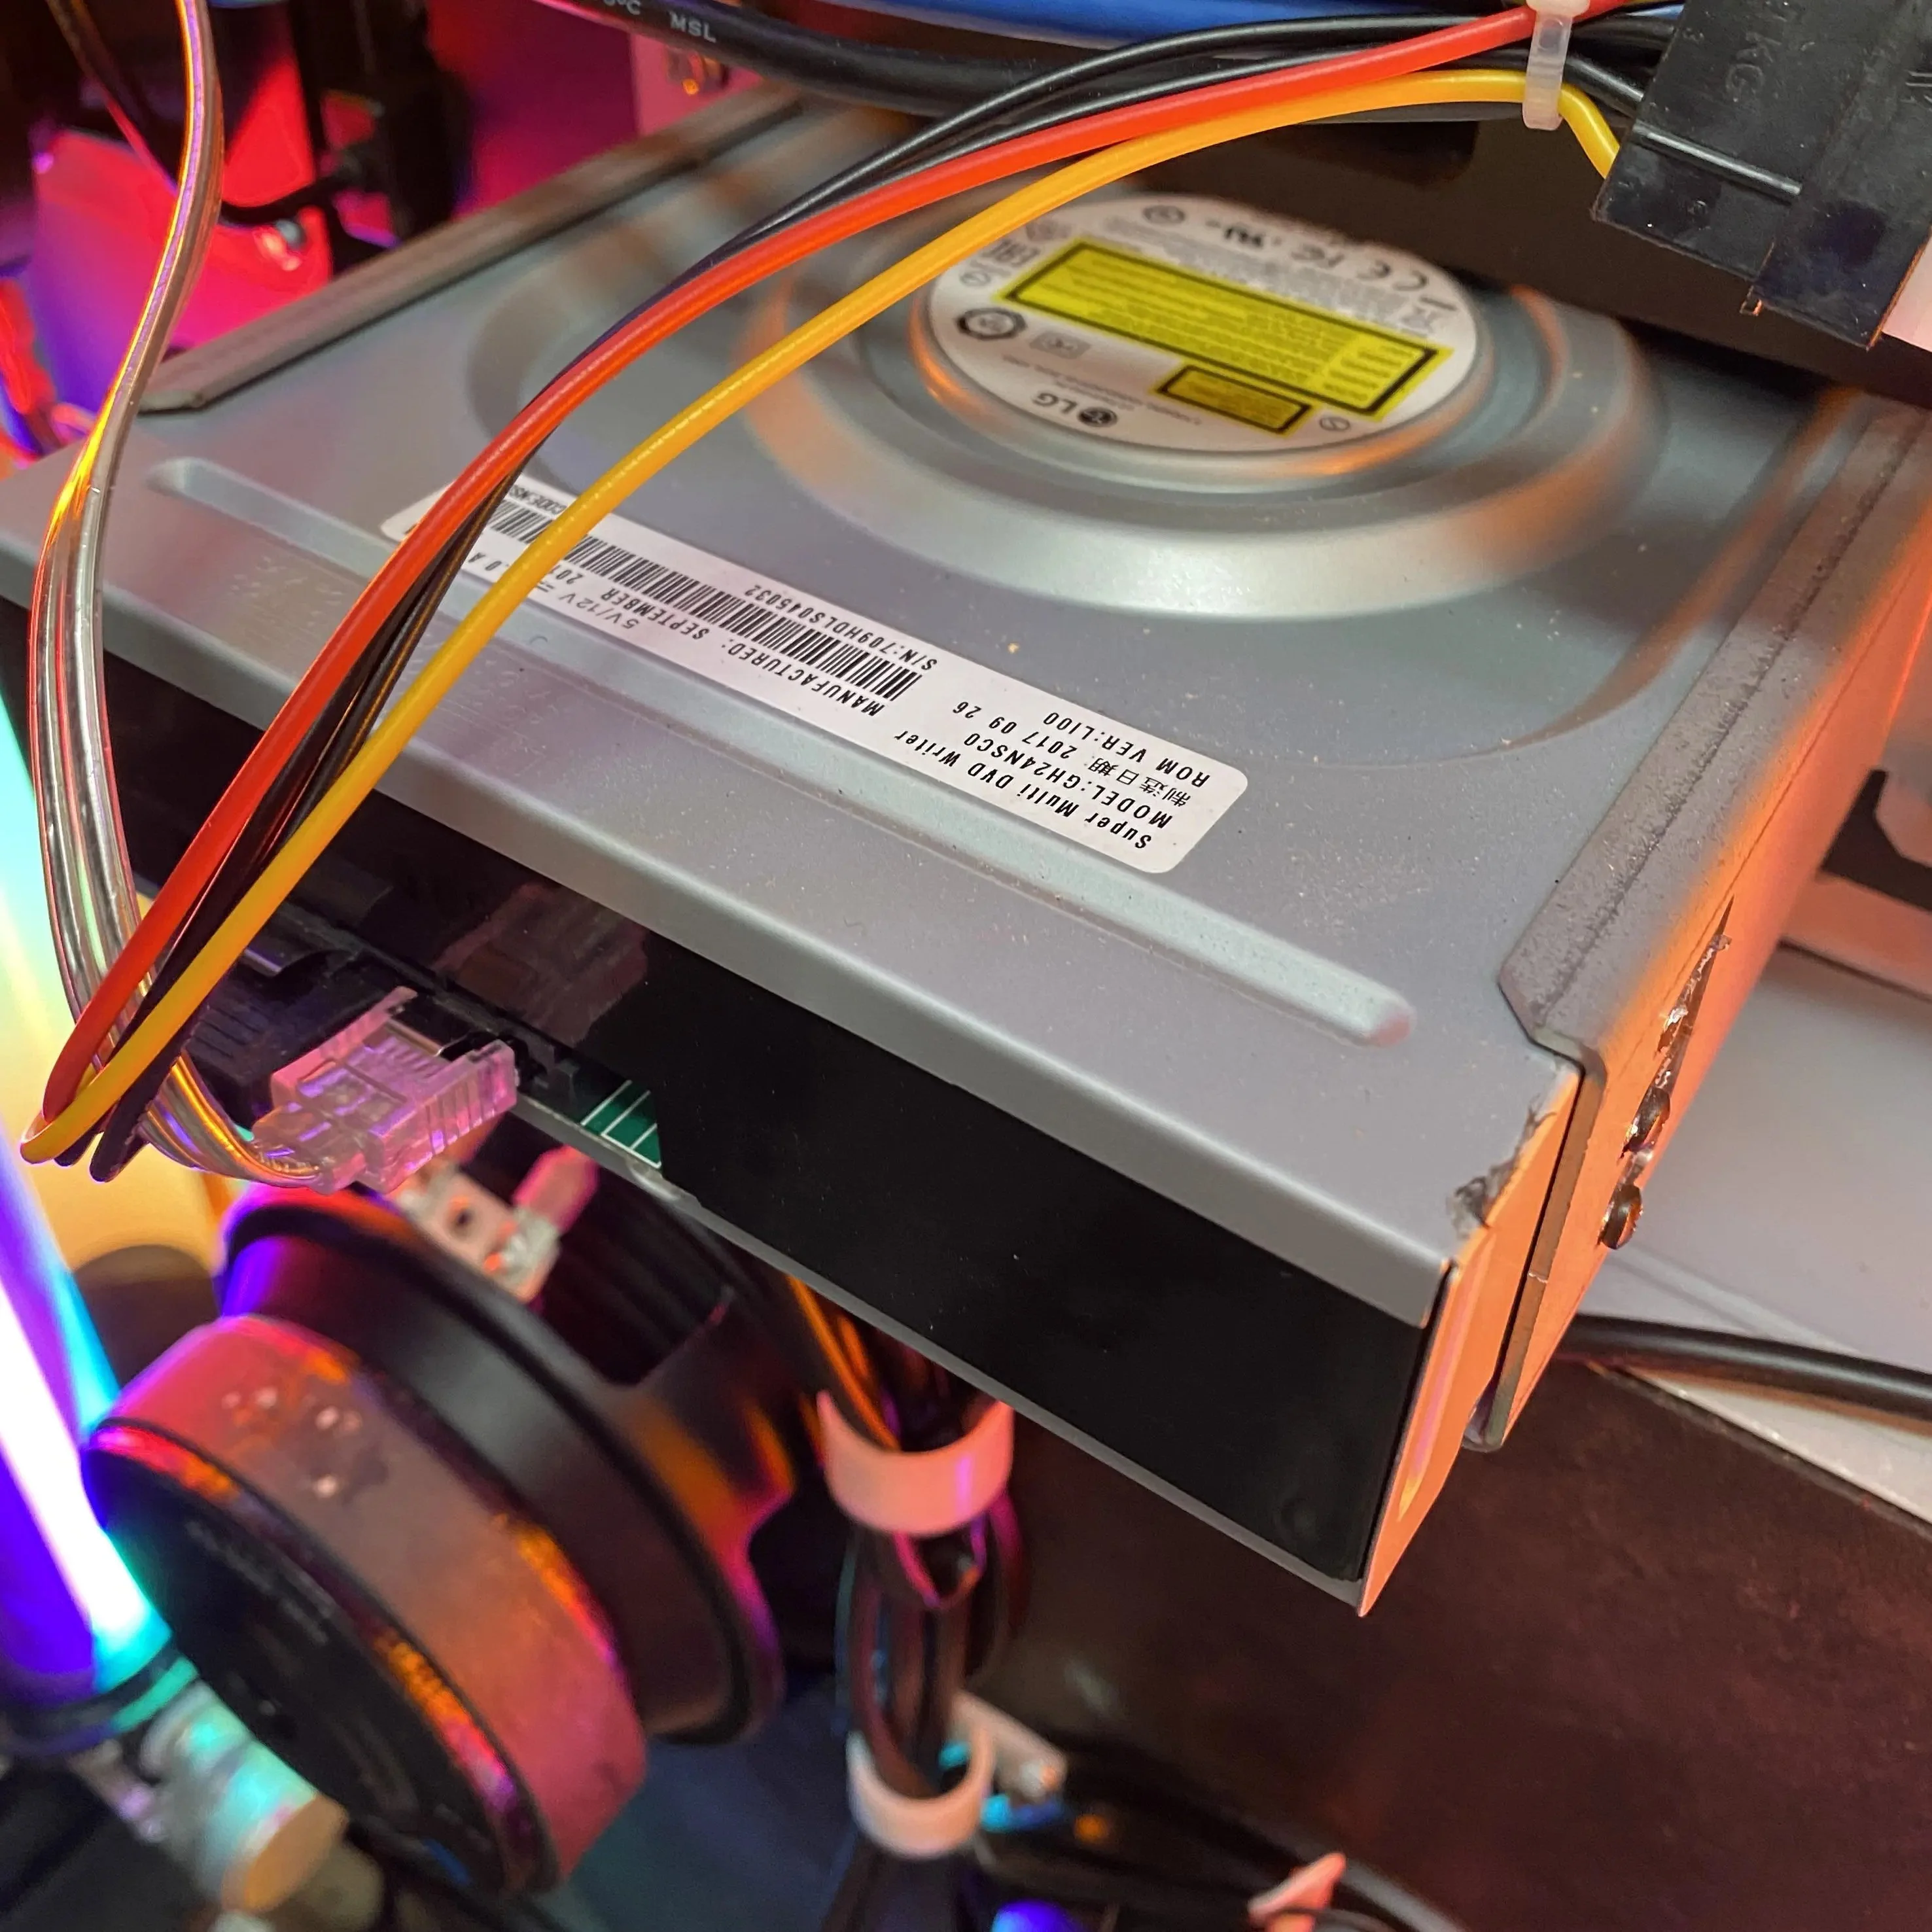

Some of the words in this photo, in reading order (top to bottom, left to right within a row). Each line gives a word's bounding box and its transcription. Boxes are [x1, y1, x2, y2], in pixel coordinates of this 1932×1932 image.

[669, 11, 717, 43] MSL
[1032, 392, 1078, 414] LG
[548, 564, 586, 585] 201
[600, 588, 710, 641] SEPTEMBER
[721, 638, 886, 717] MANUFACTURED:
[952, 701, 982, 719] 26
[988, 716, 1017, 734] 09
[893, 730, 962, 767] Writer
[1021, 731, 1078, 760] 2017
[967, 762, 1015, 789] DVD
[1155, 757, 1211, 788] ROM
[1016, 783, 1080, 818] Multi
[1084, 812, 1152, 849] Super
